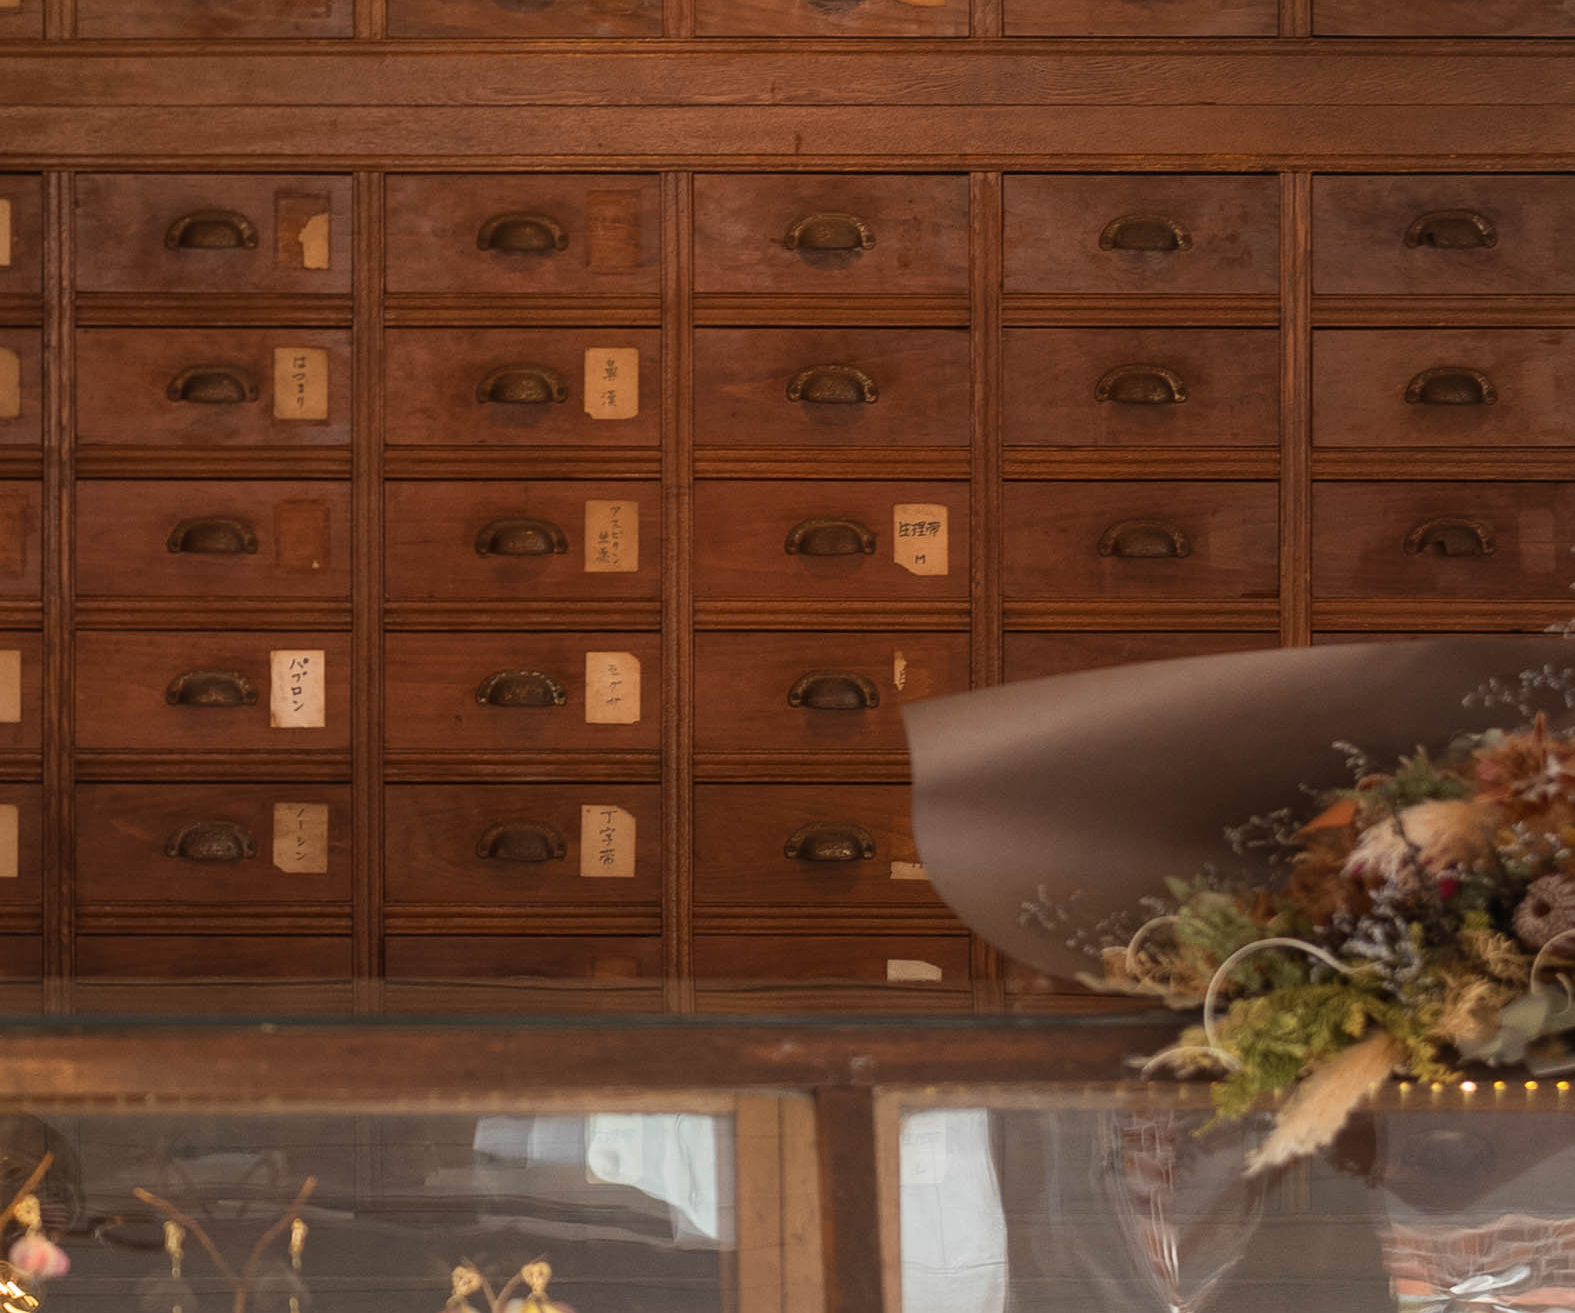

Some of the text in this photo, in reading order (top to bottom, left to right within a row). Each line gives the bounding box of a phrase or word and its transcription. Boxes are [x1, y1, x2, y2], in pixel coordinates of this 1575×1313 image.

[914, 553, 927, 565] M
[288, 657, 311, 713] パブロン
